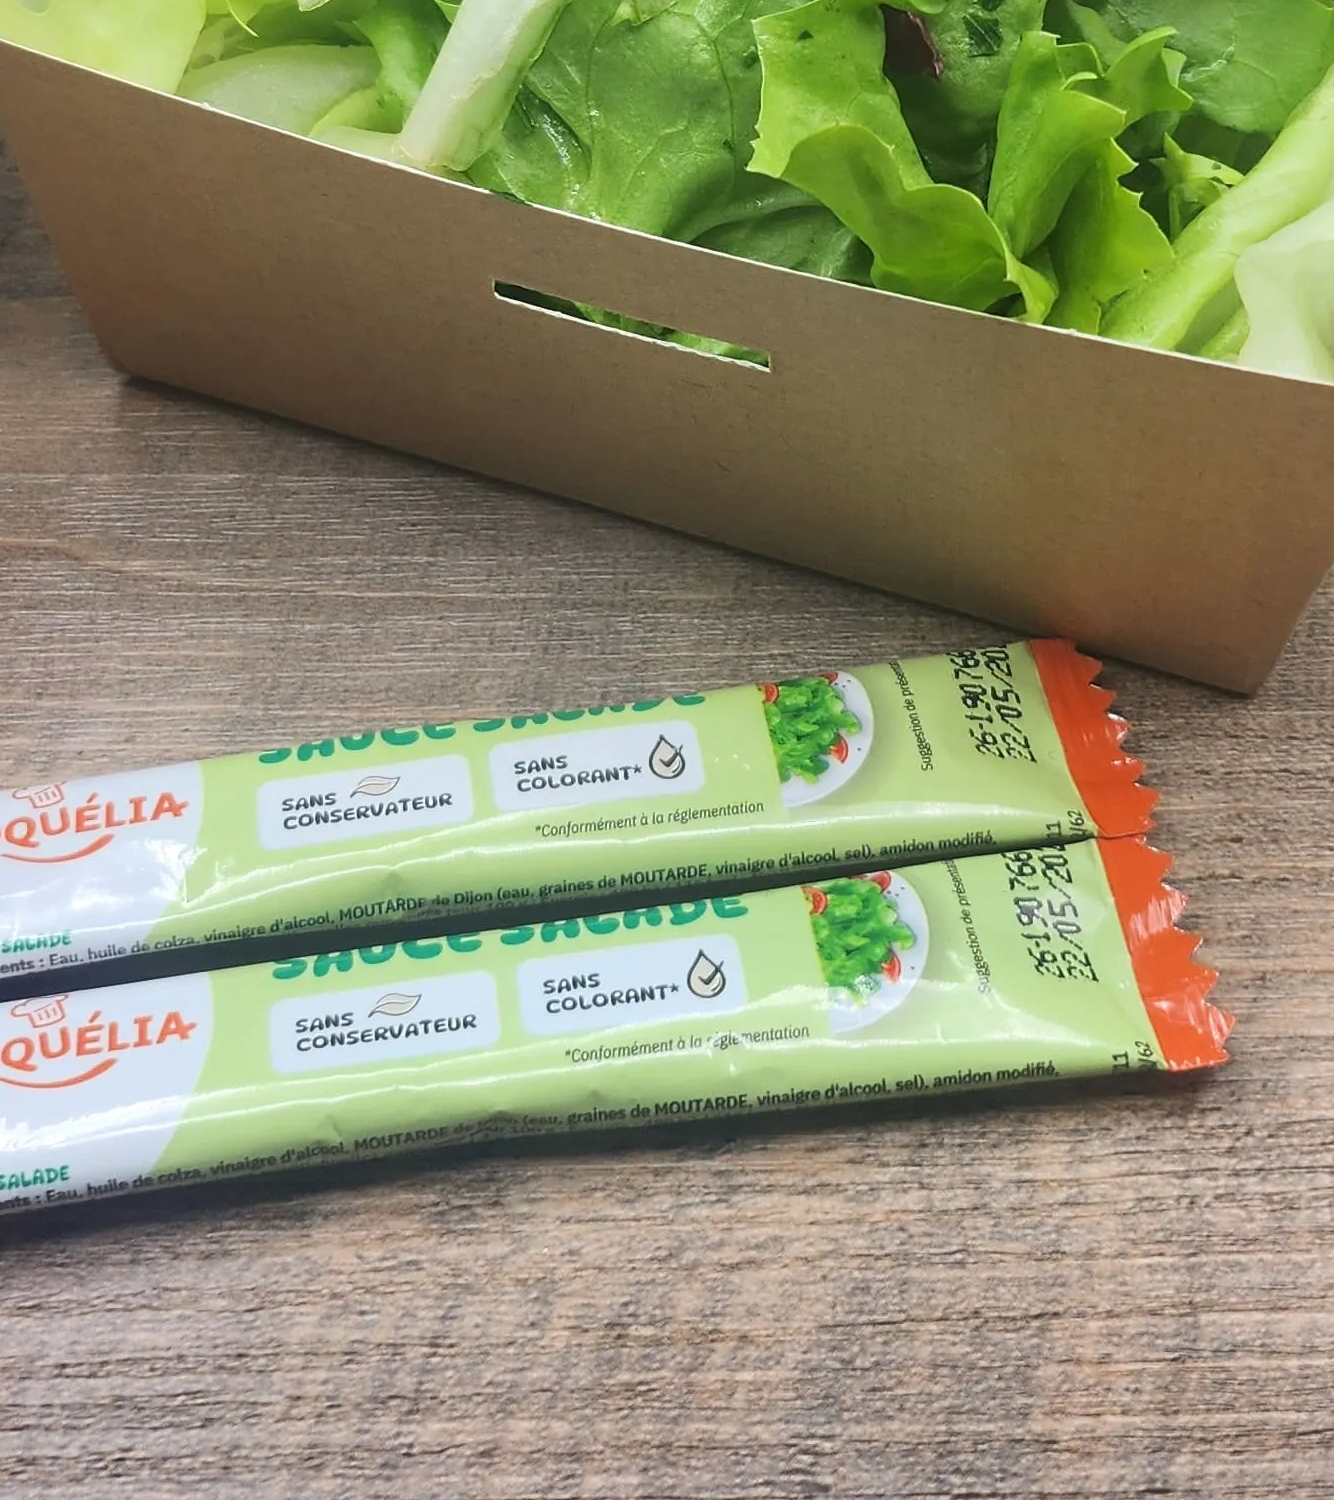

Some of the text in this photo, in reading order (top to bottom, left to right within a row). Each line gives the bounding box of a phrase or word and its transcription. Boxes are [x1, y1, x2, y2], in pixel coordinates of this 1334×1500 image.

[903, 697, 916, 711] de
[908, 712, 934, 771] Suggestion
[513, 754, 569, 775] SANS
[281, 792, 338, 812] SANS
[282, 792, 453, 830] CONSERVATEUR
[639, 813, 649, 826] à
[651, 811, 665, 825] la
[668, 800, 765, 824] réglementation
[87, 942, 127, 961] huile
[130, 939, 151, 954] de
[204, 925, 267, 944] vinaigre
[454, 889, 493, 907] Dijon
[539, 878, 594, 900] graines
[598, 874, 616, 888] de
[716, 857, 775, 877] vinaigre
[879, 839, 935, 857] amidon
[959, 910, 973, 925] de
[1, 930, 73, 954] SALADE
[543, 972, 601, 995] SANS
[295, 1012, 354, 1033] SANS
[296, 1013, 477, 1052] CONSERVATEUR
[677, 1036, 686, 1050] à
[689, 1034, 703, 1049] la
[87, 1176, 130, 1196] huile
[132, 1174, 155, 1189] de
[210, 1153, 278, 1176] vinaigre
[354, 1125, 449, 1152] MOUTARDE
[567, 1105, 627, 1128] graines
[630, 1103, 651, 1118] de
[756, 1087, 822, 1107] vinaigre
[933, 1068, 993, 1088] amidon
